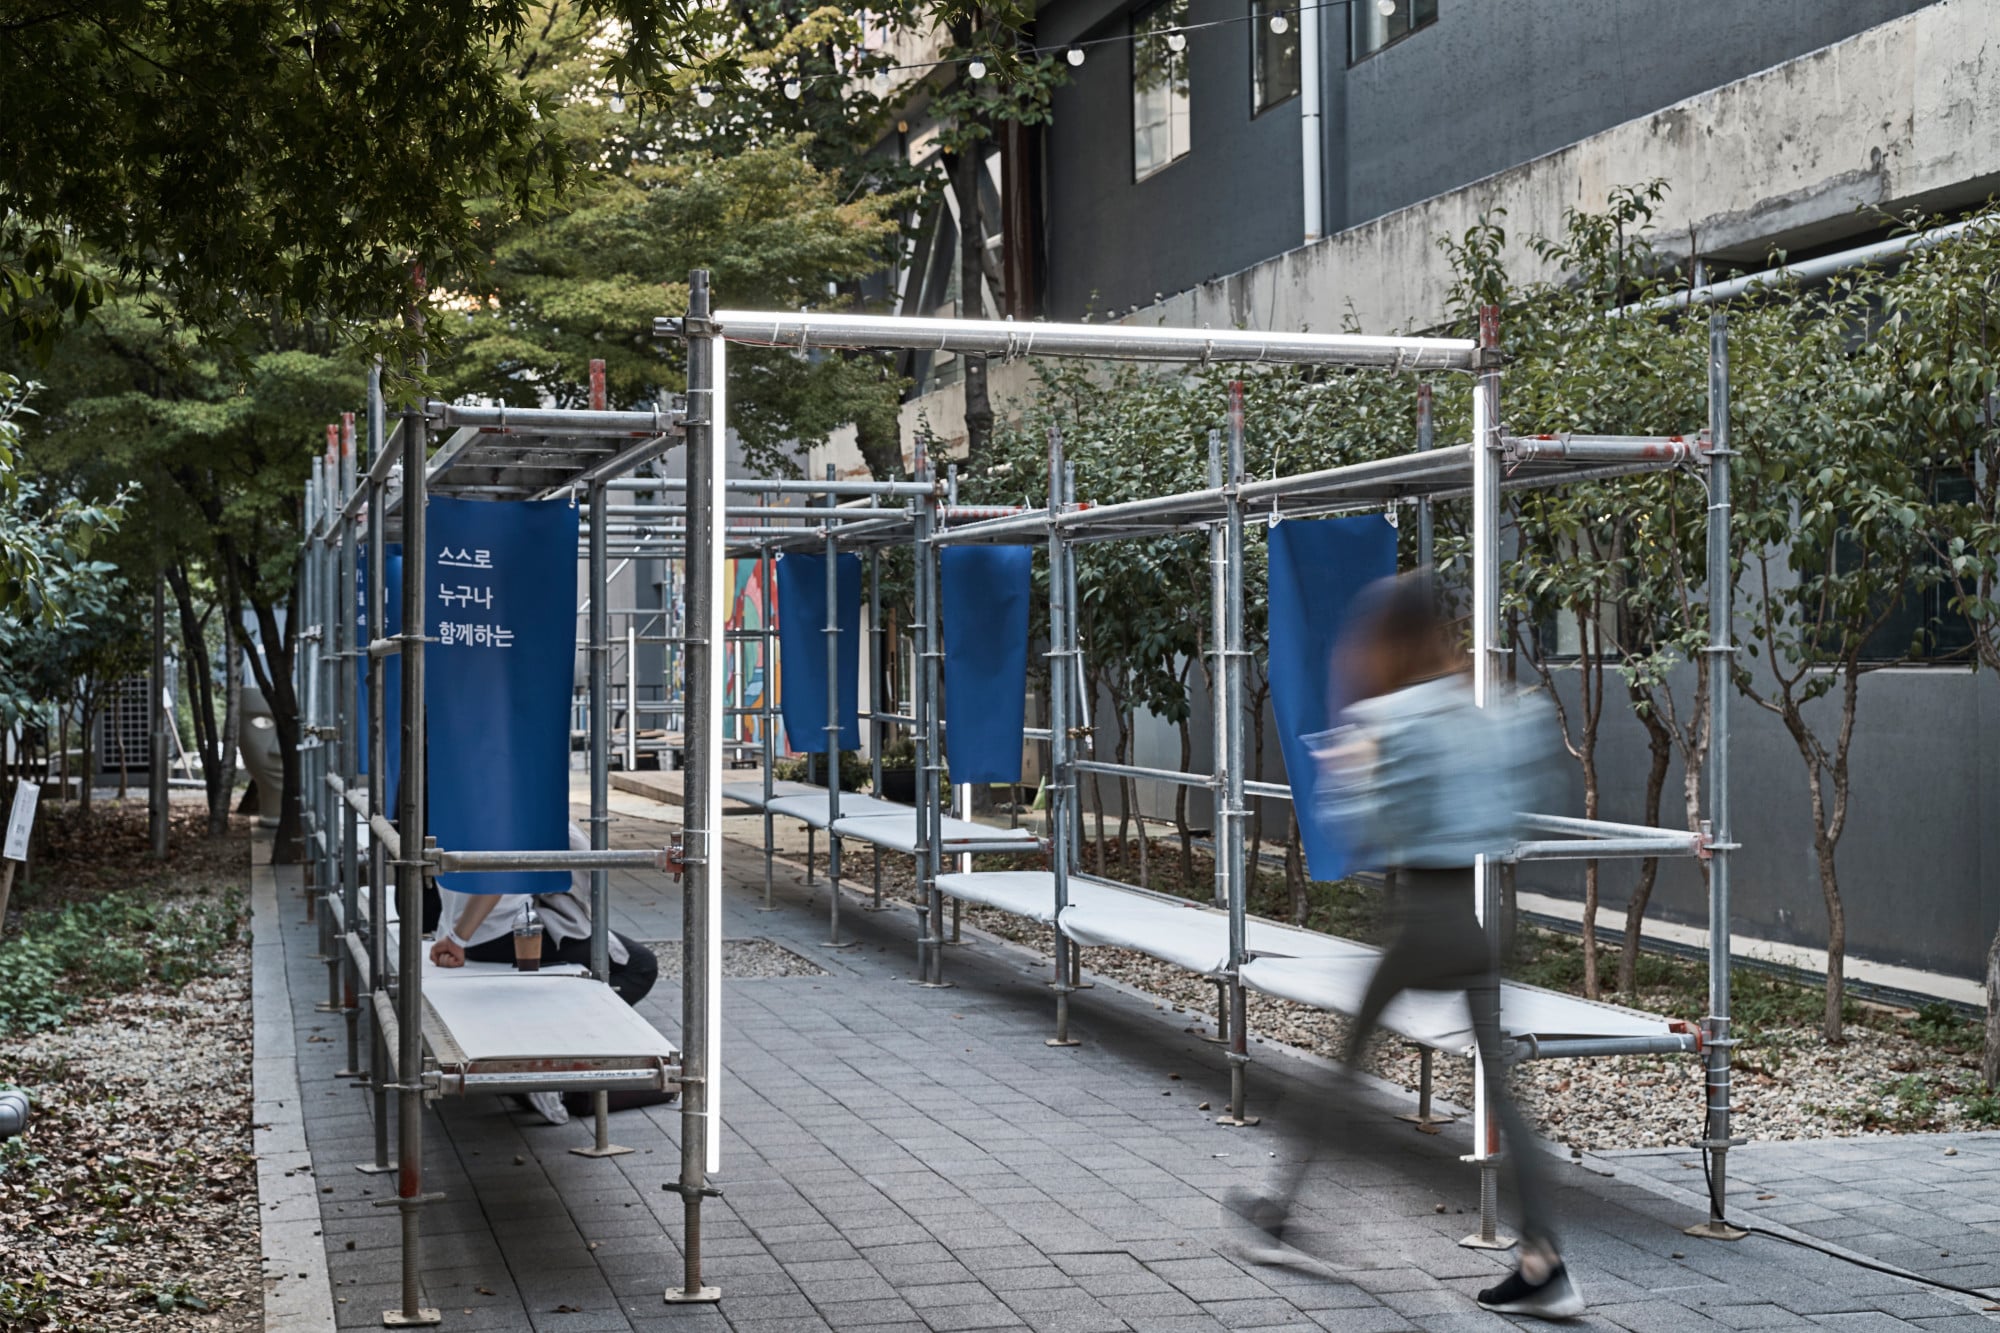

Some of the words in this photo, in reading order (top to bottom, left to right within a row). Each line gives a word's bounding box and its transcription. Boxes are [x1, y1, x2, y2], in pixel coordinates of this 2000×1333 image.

[438, 546, 494, 569] 스스로
[438, 583, 494, 610] 누구나
[439, 621, 515, 648] 함께하는
